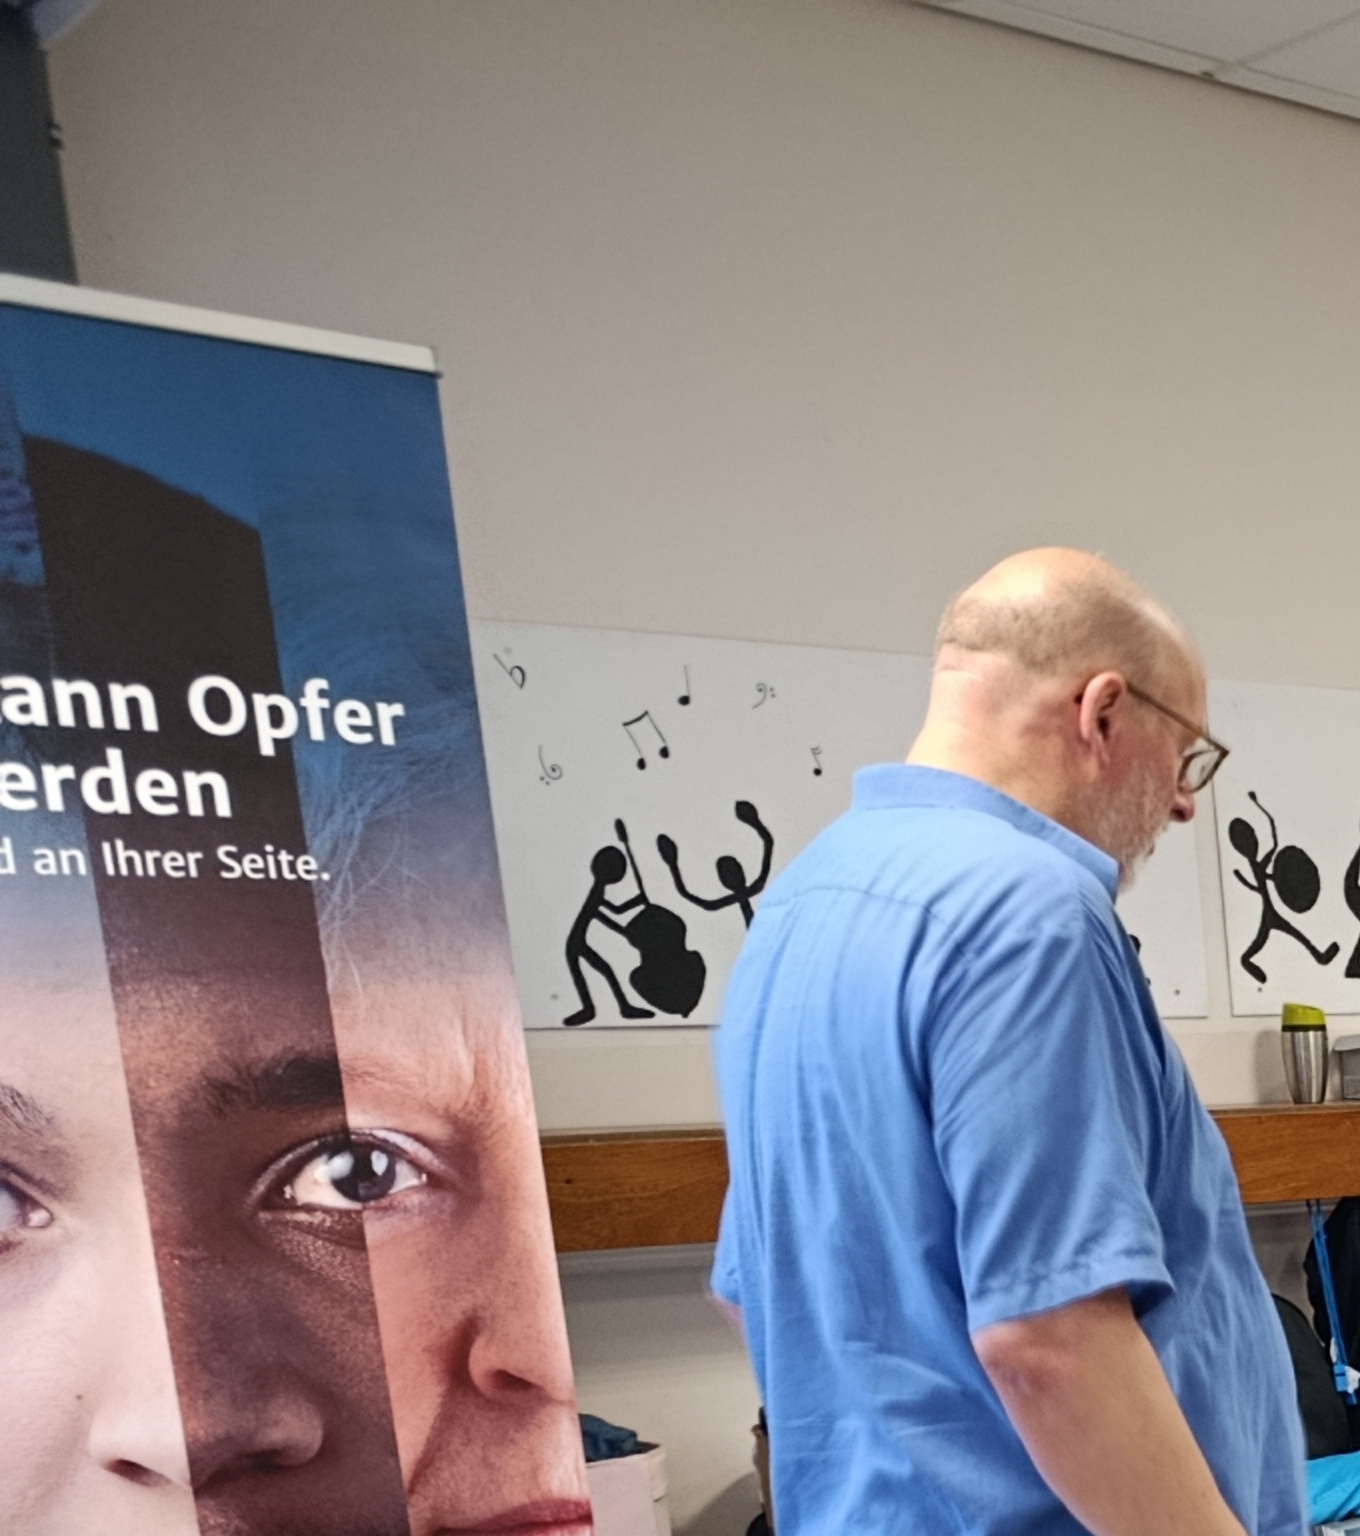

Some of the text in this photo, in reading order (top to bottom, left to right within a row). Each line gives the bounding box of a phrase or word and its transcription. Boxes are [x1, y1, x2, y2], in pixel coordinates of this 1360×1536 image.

[0, 674, 405, 757] ann Opfer
[34, 847, 87, 875] an
[101, 837, 203, 878] Ihrer
[217, 843, 331, 881] Seite.
